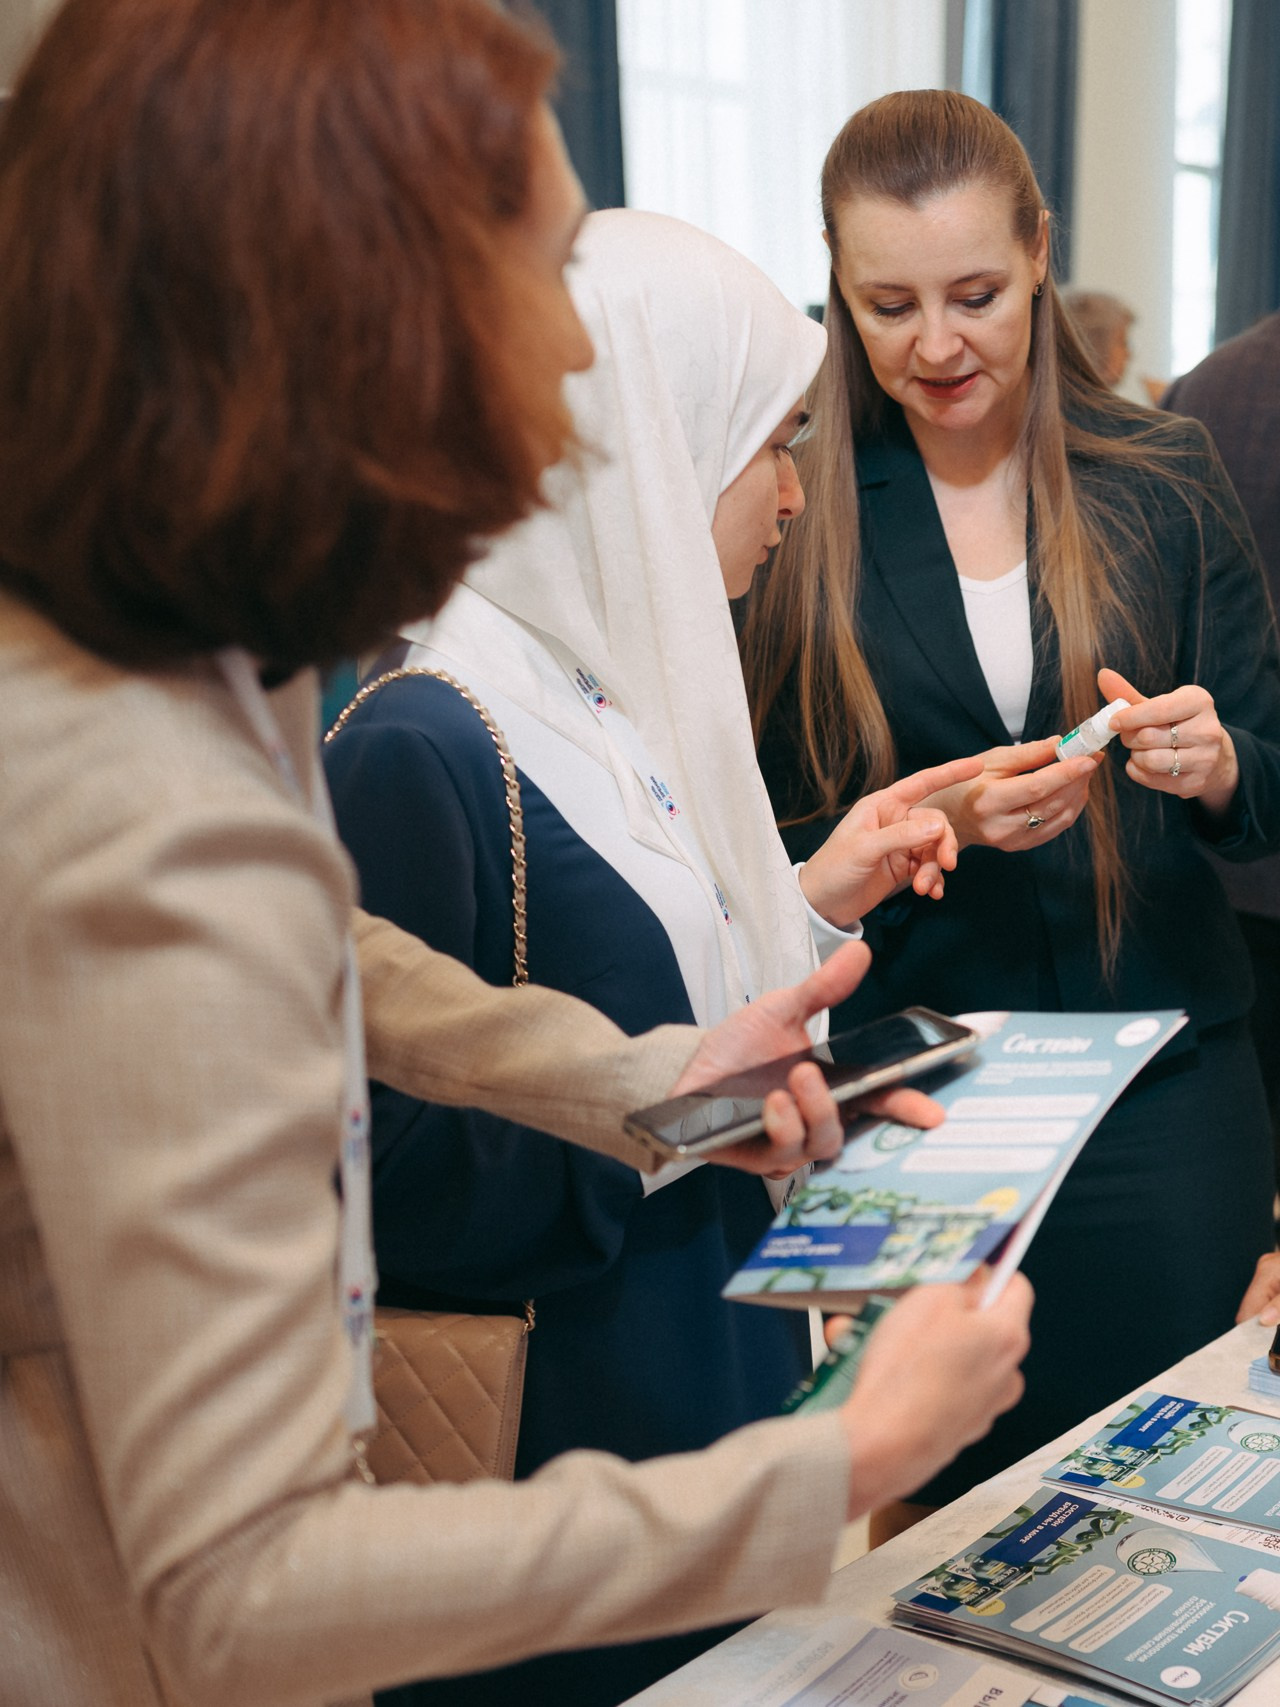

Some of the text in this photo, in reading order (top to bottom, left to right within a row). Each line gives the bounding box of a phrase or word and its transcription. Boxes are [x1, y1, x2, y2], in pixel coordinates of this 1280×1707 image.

[1047, 1504, 1082, 1527] СИСТЕЙН
[1048, 1501, 1073, 1517] БРЕНД
[1039, 1516, 1054, 1525] №1
